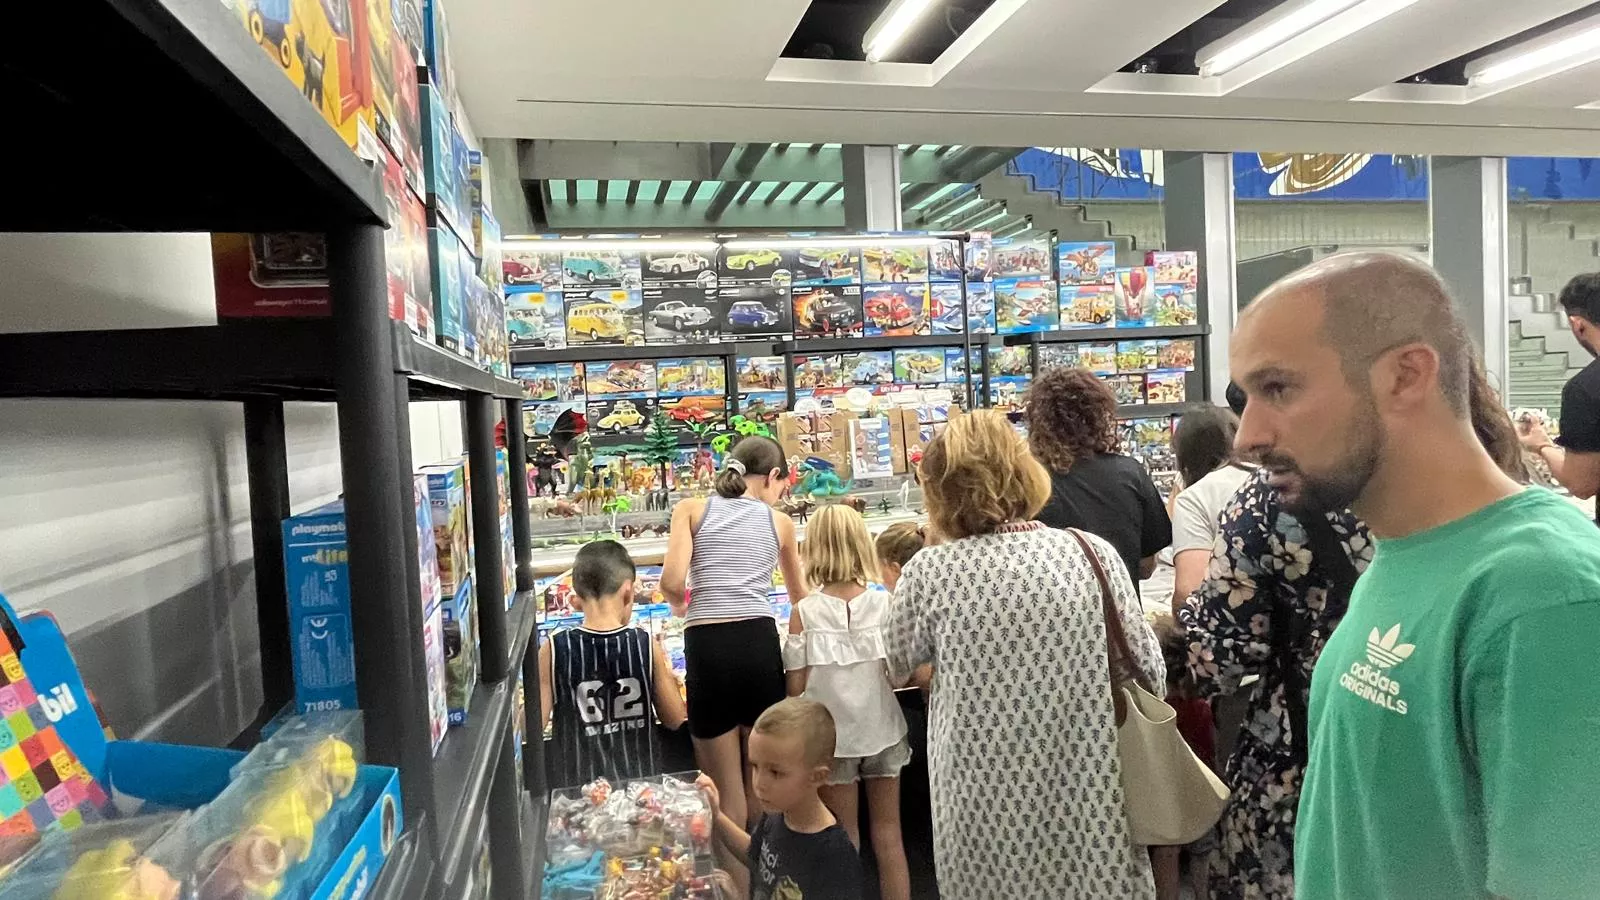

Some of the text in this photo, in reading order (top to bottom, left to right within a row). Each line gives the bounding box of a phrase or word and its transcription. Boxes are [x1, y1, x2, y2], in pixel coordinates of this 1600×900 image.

[292, 521, 346, 537] playmob
[1339, 672, 1408, 715] ORIGINALS
[1351, 662, 1400, 696] adidas
[304, 699, 341, 713] 71805
[576, 677, 644, 723] 62
